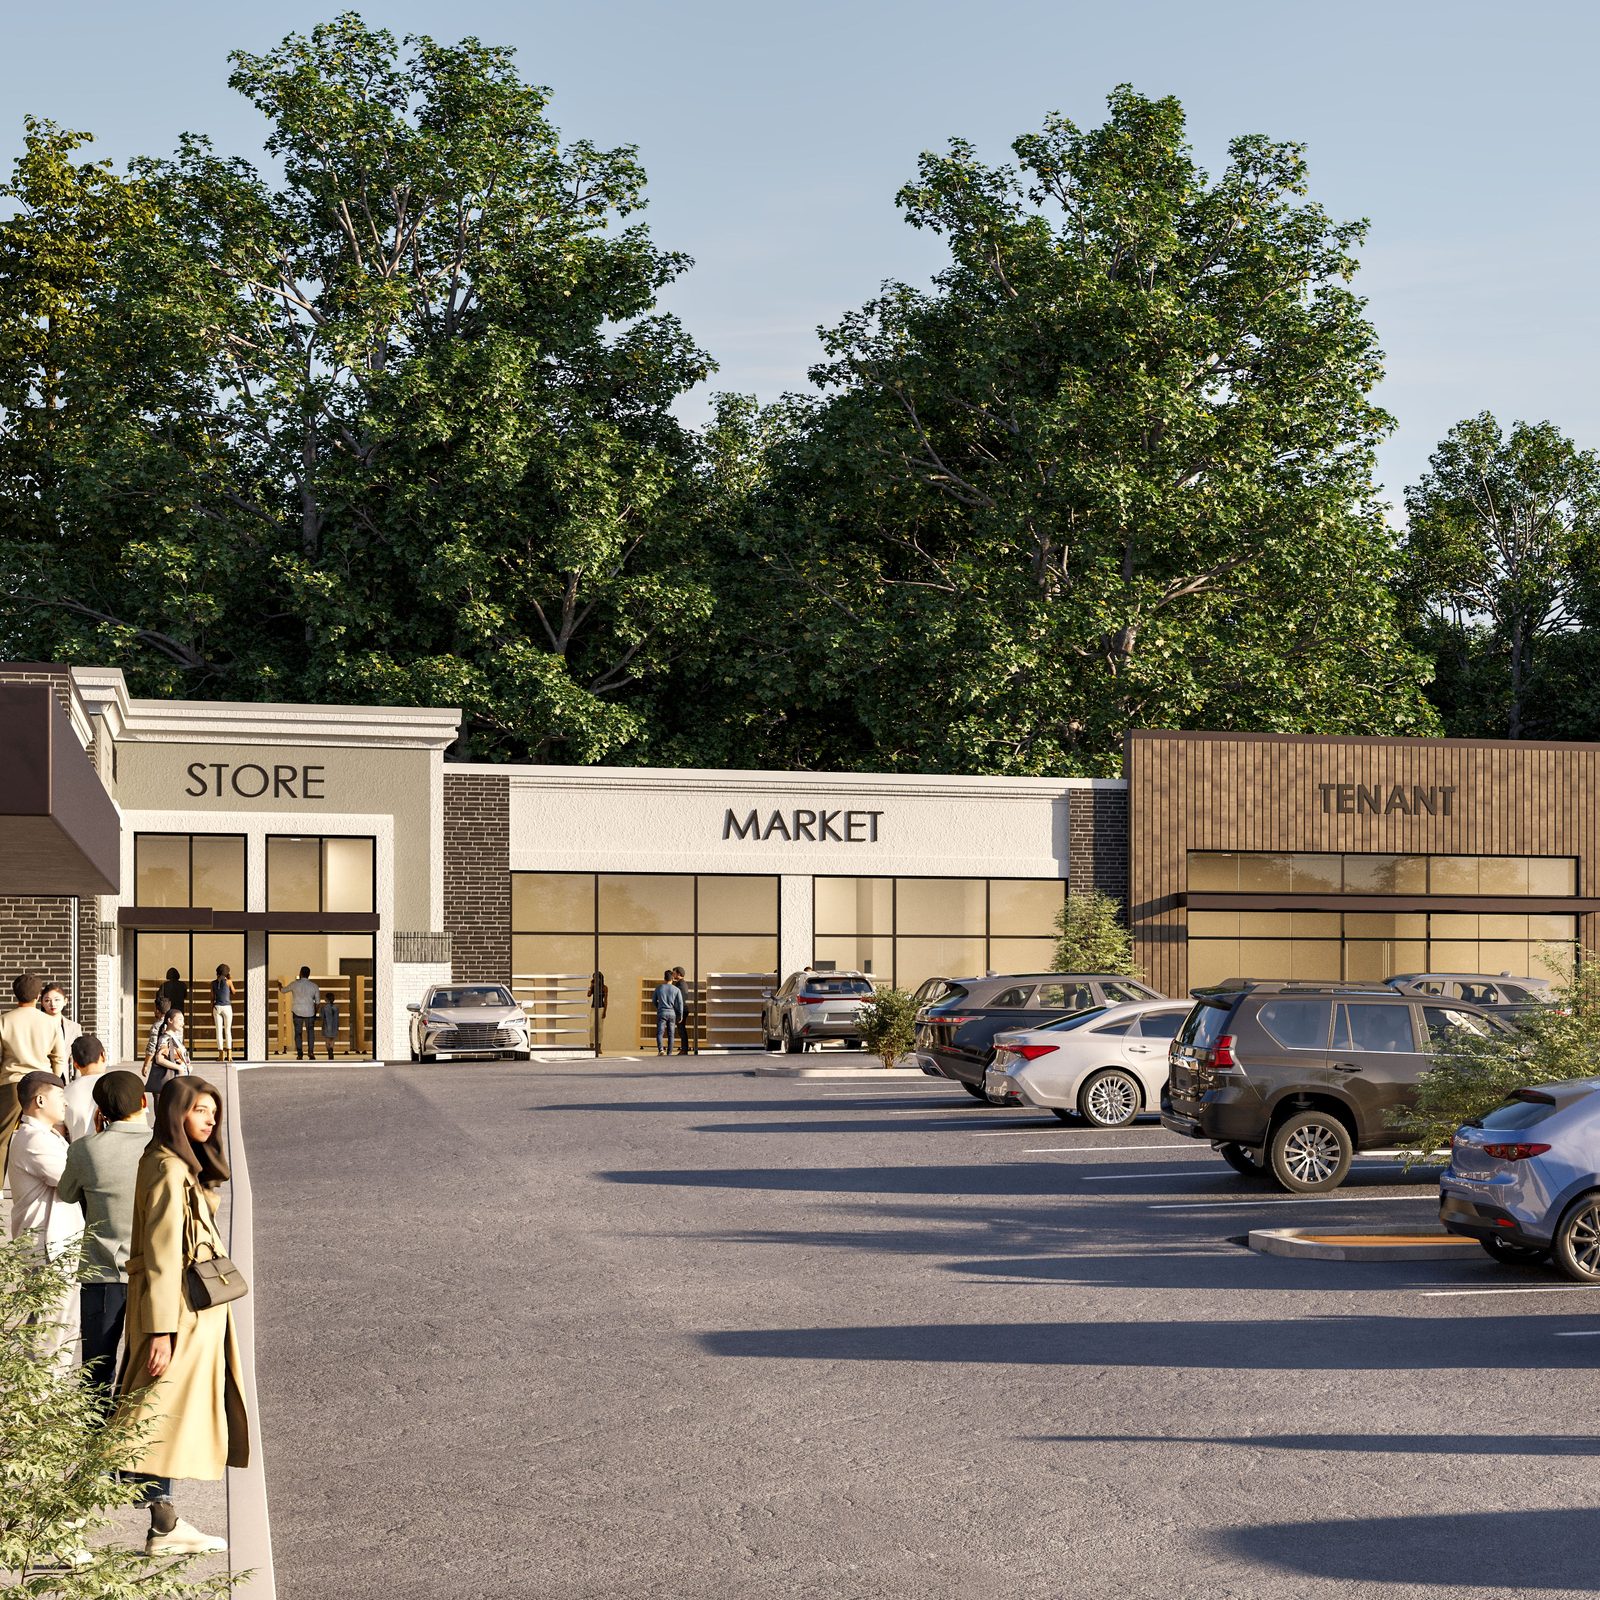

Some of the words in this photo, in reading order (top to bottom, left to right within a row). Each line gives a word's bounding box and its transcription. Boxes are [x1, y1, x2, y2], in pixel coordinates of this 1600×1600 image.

[185, 763, 325, 799] STORE
[1319, 784, 1456, 815] TENANT
[722, 808, 884, 842] MARKET
